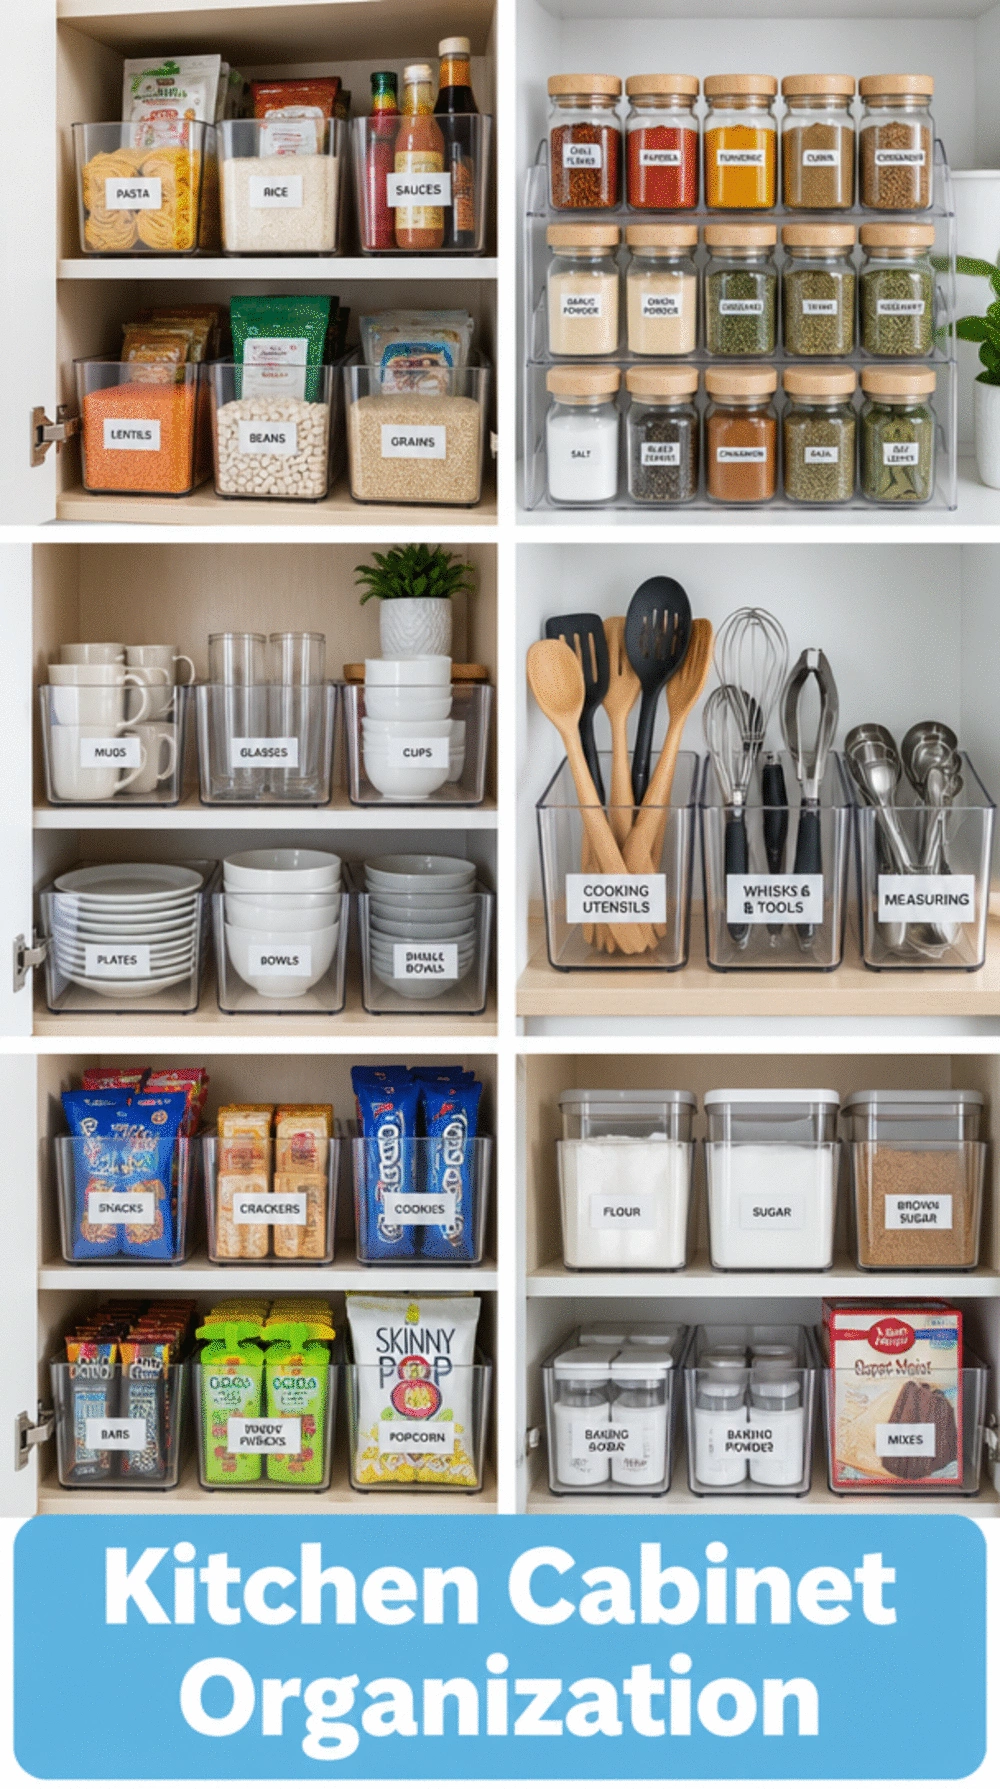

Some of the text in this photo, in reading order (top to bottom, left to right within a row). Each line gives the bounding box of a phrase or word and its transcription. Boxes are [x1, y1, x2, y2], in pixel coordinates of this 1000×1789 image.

[116, 188, 150, 199] PASTA
[263, 186, 288, 198] RICE
[395, 183, 442, 196] SAUCES
[110, 429, 152, 440] LENTILS
[249, 433, 287, 444] BEANS
[390, 436, 436, 448] GRAINS
[571, 449, 591, 459] SALT
[94, 747, 127, 758] MUGS
[239, 747, 289, 758] GLASSES
[402, 747, 433, 758] CUPS
[583, 884, 649, 898] COOKING
[742, 884, 798, 898] WHISKS
[884, 893, 970, 906] MEASURING
[583, 900, 650, 914] UTENSILS
[756, 900, 804, 914] TOOLS
[97, 954, 138, 966] PLATES
[260, 955, 299, 966] BOWLS
[98, 1203, 144, 1214] SNACKS
[239, 1203, 301, 1215] CRACKERS
[394, 1204, 446, 1215] COOKIES
[603, 1206, 641, 1218] FLOUR
[752, 1206, 792, 1218] SUGAR
[899, 1213, 937, 1225] SUGAR
[376, 1327, 456, 1355] SKINNY
[101, 1429, 130, 1440] BARS
[389, 1431, 446, 1443] POPCORN
[887, 1434, 924, 1445] MIXES
